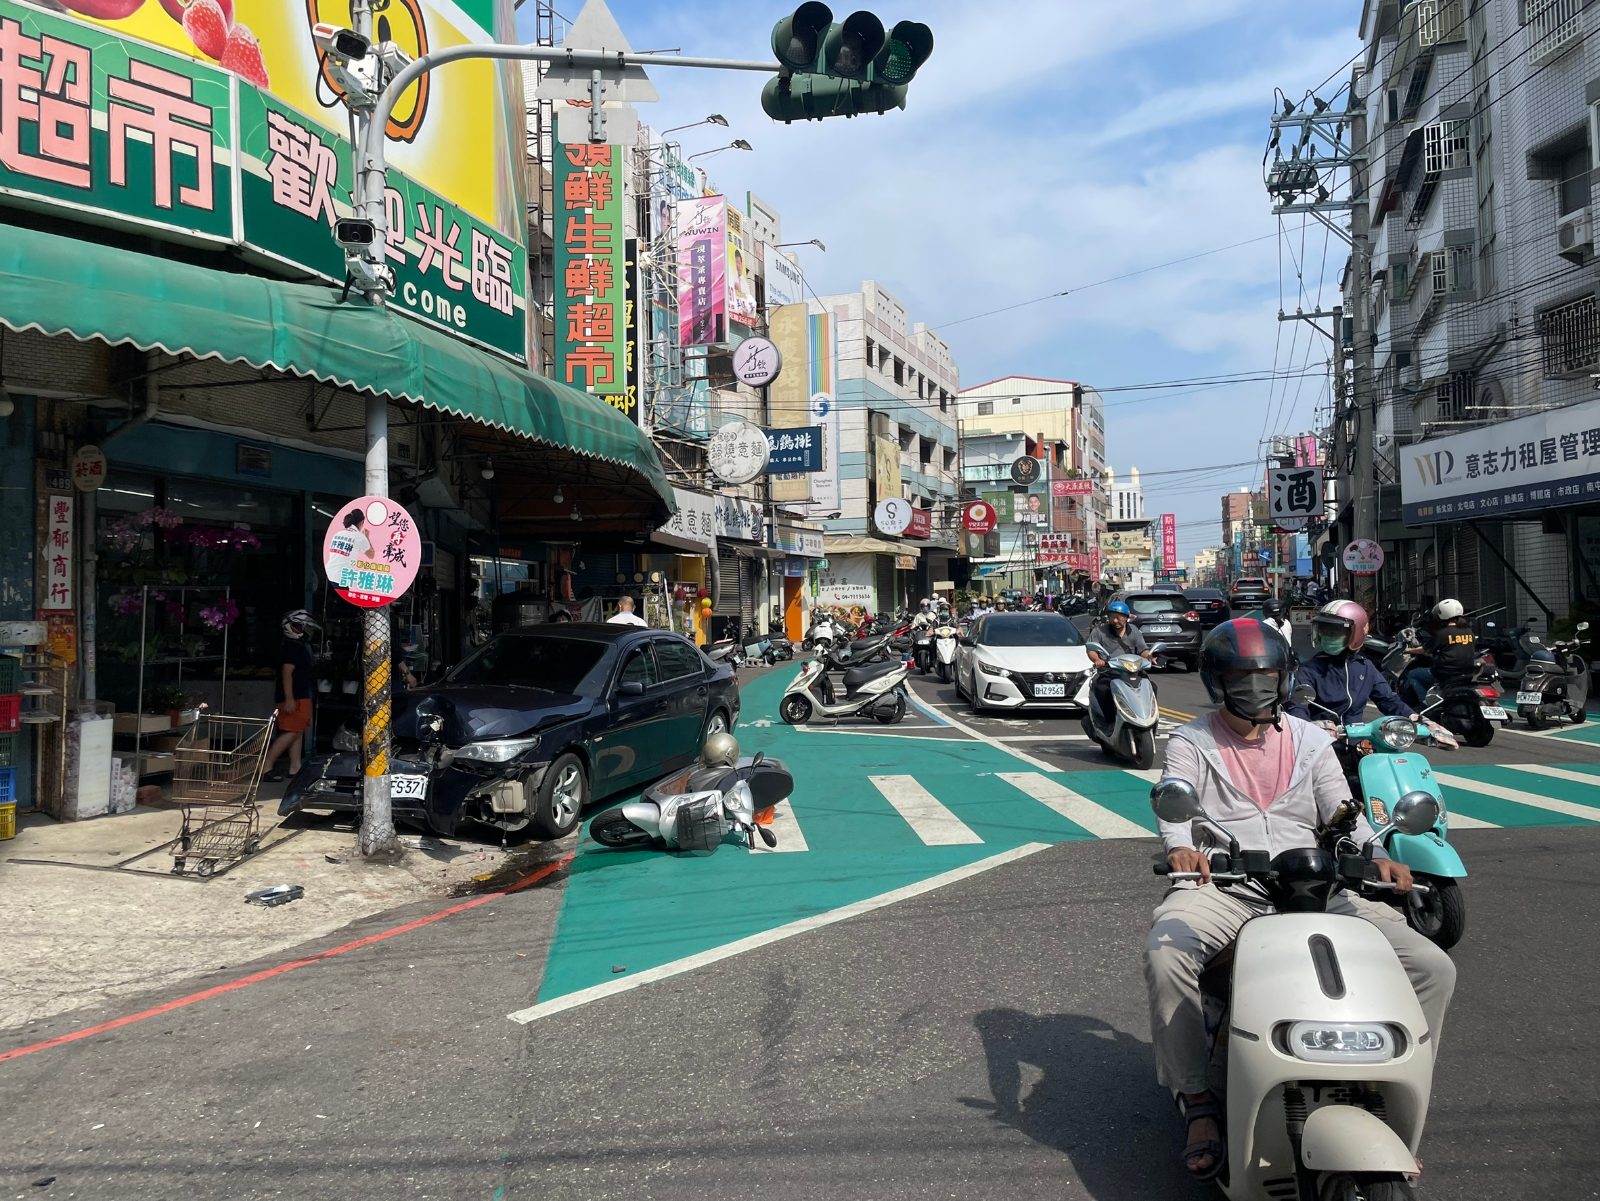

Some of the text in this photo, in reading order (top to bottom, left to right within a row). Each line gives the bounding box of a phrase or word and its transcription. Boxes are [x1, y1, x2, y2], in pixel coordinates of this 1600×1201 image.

[0, 18, 214, 211] 超市
[684, 227, 719, 237] WUWIN
[775, 258, 801, 285] SAMSUNG
[711, 440, 763, 459] 鍋燒意麵
[1465, 428, 1600, 479] 意志力租屋管理
[1274, 470, 1317, 513] 酒
[1557, 484, 1580, 497] 市政店
[664, 507, 712, 537] 燒意麵
[1279, 518, 1304, 526] CITY
[51, 500, 70, 604] 豐郁商行
[339, 567, 394, 594] 許雅琳
[1448, 633, 1473, 645] Laya
